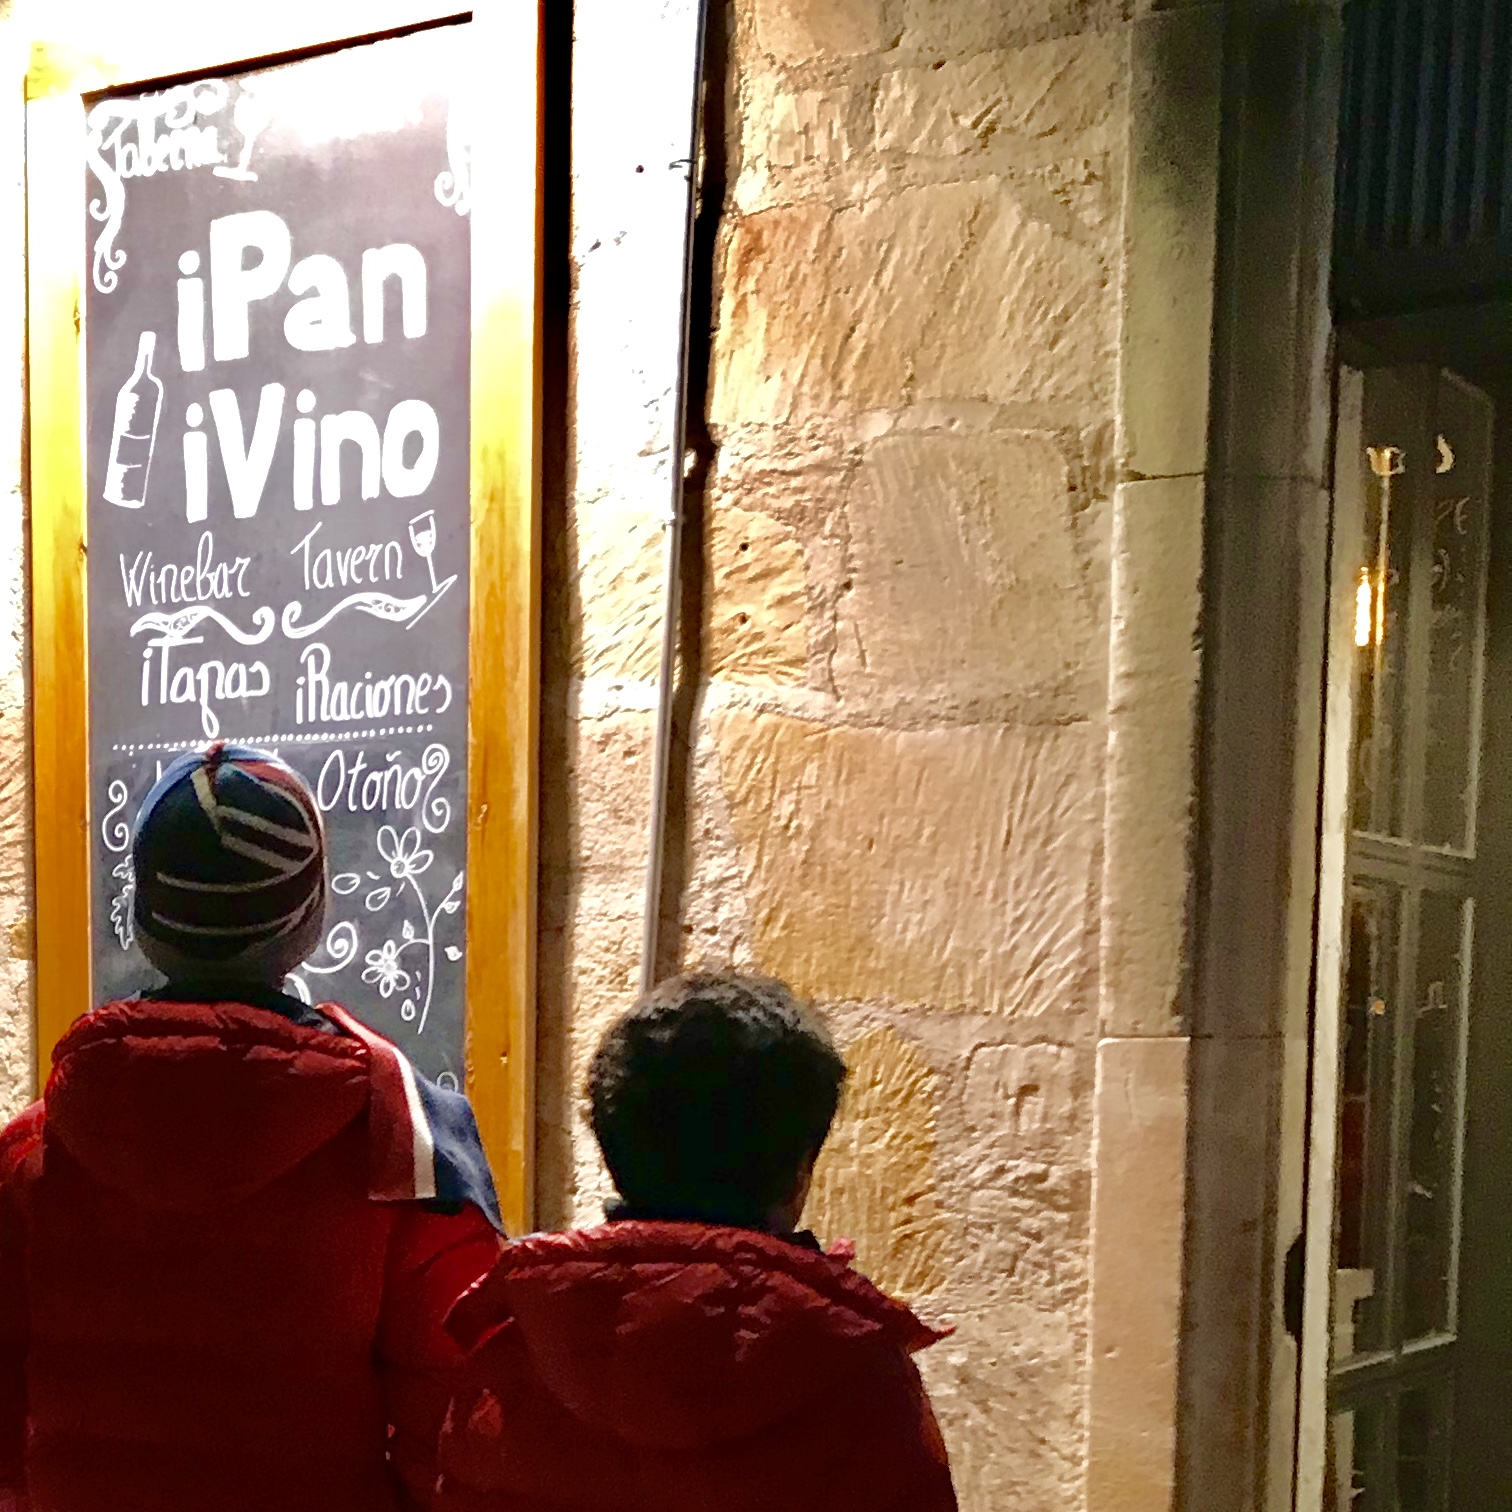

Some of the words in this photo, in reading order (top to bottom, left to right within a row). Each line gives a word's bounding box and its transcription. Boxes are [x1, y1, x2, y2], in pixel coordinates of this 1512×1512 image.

[119, 531, 252, 608] Winebar
[290, 522, 403, 590] Tavern
[316, 747, 426, 812] Otoño
